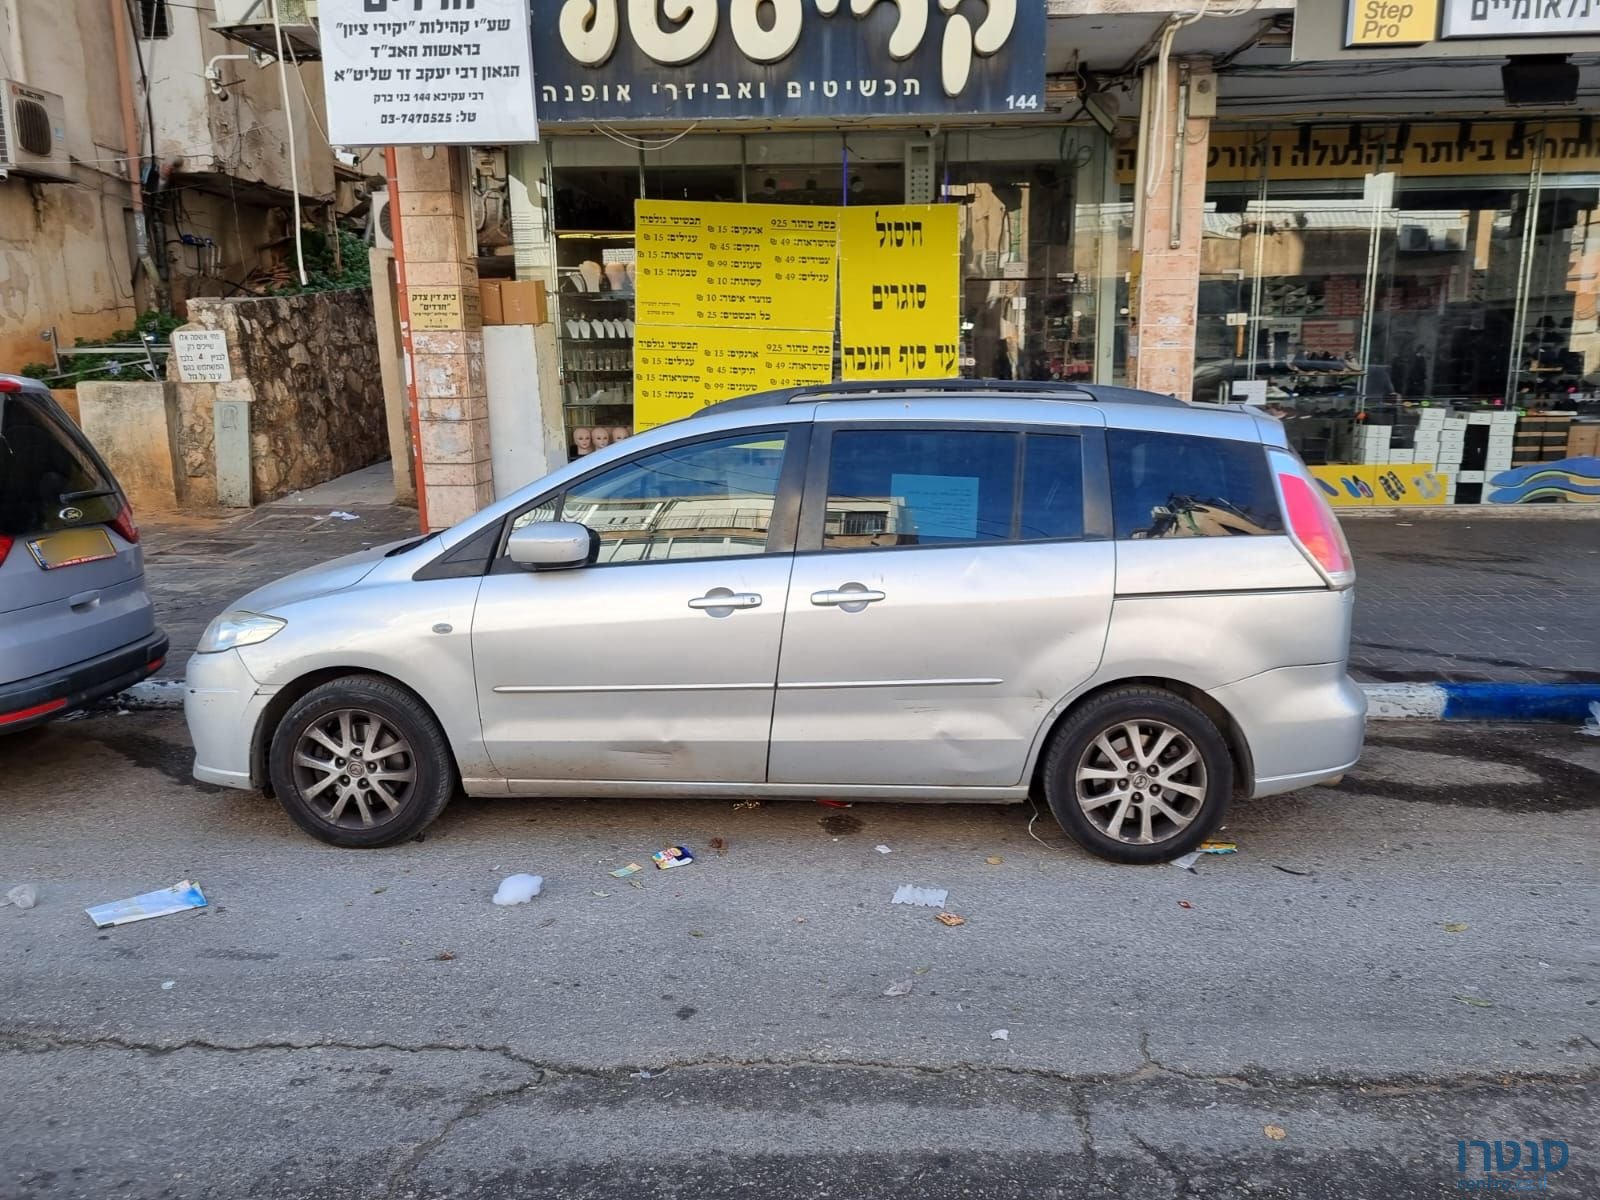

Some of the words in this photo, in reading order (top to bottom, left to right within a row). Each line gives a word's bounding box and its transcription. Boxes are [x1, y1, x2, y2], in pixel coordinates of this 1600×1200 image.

[1363, 1, 1413, 26] Step
[420, 20, 469, 35] קהילות
[1362, 21, 1399, 39] Pro
[422, 43, 480, 57] בראשות
[416, 67, 451, 82] יעקב
[455, 67, 477, 79] רבי
[482, 65, 520, 81] הגאון
[542, 84, 632, 104] אופנה
[651, 80, 767, 101] ואביזרי
[787, 79, 921, 98] תכשיטים
[373, 94, 393, 105] ברק
[396, 93, 410, 103] בני
[413, 92, 430, 102] 144
[433, 92, 465, 103] עקיבא
[468, 91, 484, 101] רבי
[1006, 95, 1039, 110] 144
[380, 113, 452, 125] 03-7470525
[456, 110, 476, 122] טל:
[718, 225, 727, 233] 15
[771, 219, 788, 228] 925
[876, 210, 922, 248] חיסול
[655, 233, 663, 241] 15
[781, 238, 790, 246] 49
[720, 243, 730, 251] 45
[717, 277, 727, 285] 10
[786, 273, 795, 281] 49
[707, 294, 717, 302] 10
[872, 284, 926, 310] סוגרים
[707, 311, 717, 319] 25
[766, 344, 783, 352] 925
[715, 350, 724, 358] 15
[844, 346, 891, 371] חנוכה
[935, 345, 955, 371] עד
[653, 357, 661, 365] 15
[776, 362, 785, 370] 49
[899, 345, 926, 376] סוף
[717, 366, 726, 374] 45
[653, 391, 661, 399] 15
